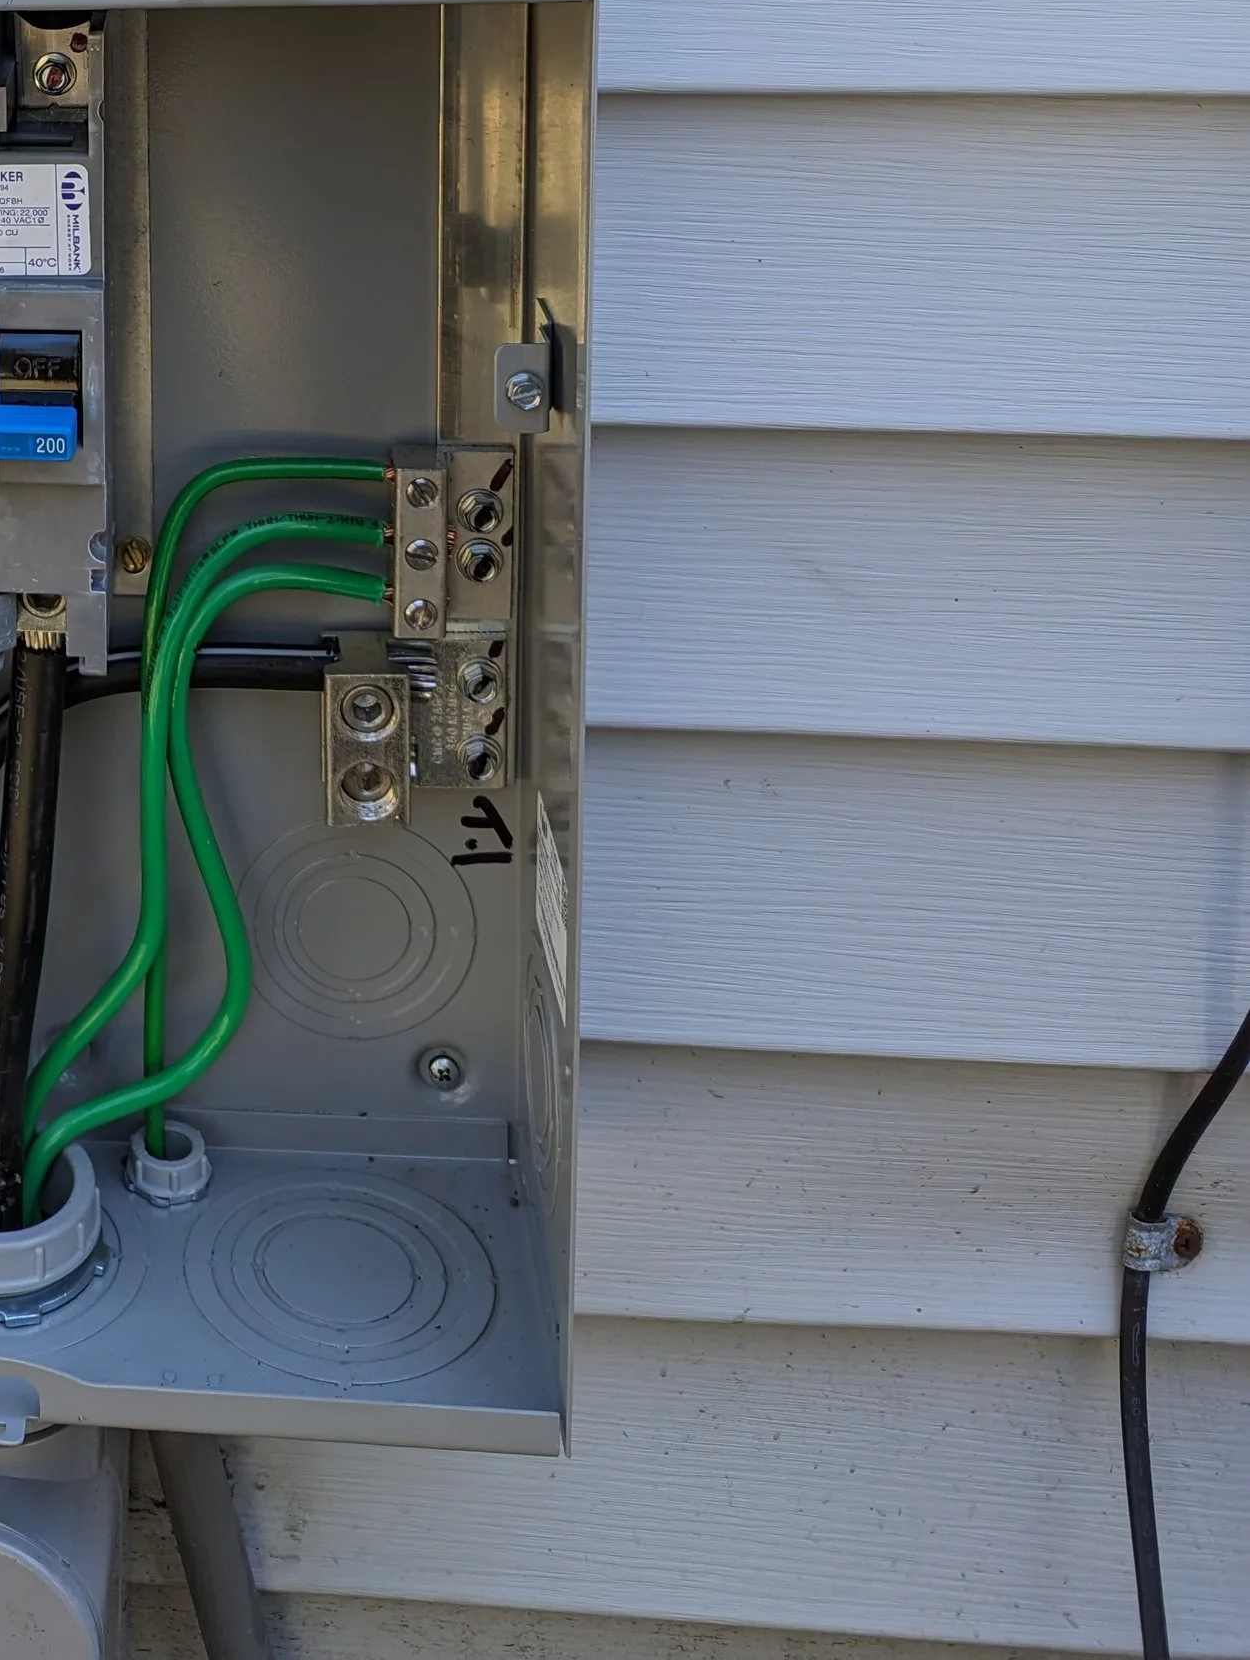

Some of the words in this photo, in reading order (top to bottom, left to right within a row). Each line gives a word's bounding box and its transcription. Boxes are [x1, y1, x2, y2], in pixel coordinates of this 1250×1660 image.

[5, 229, 19, 237] CU
[72, 214, 82, 272] MILBANK
[13, 356, 61, 378] OFF
[36, 437, 65, 454] 200
